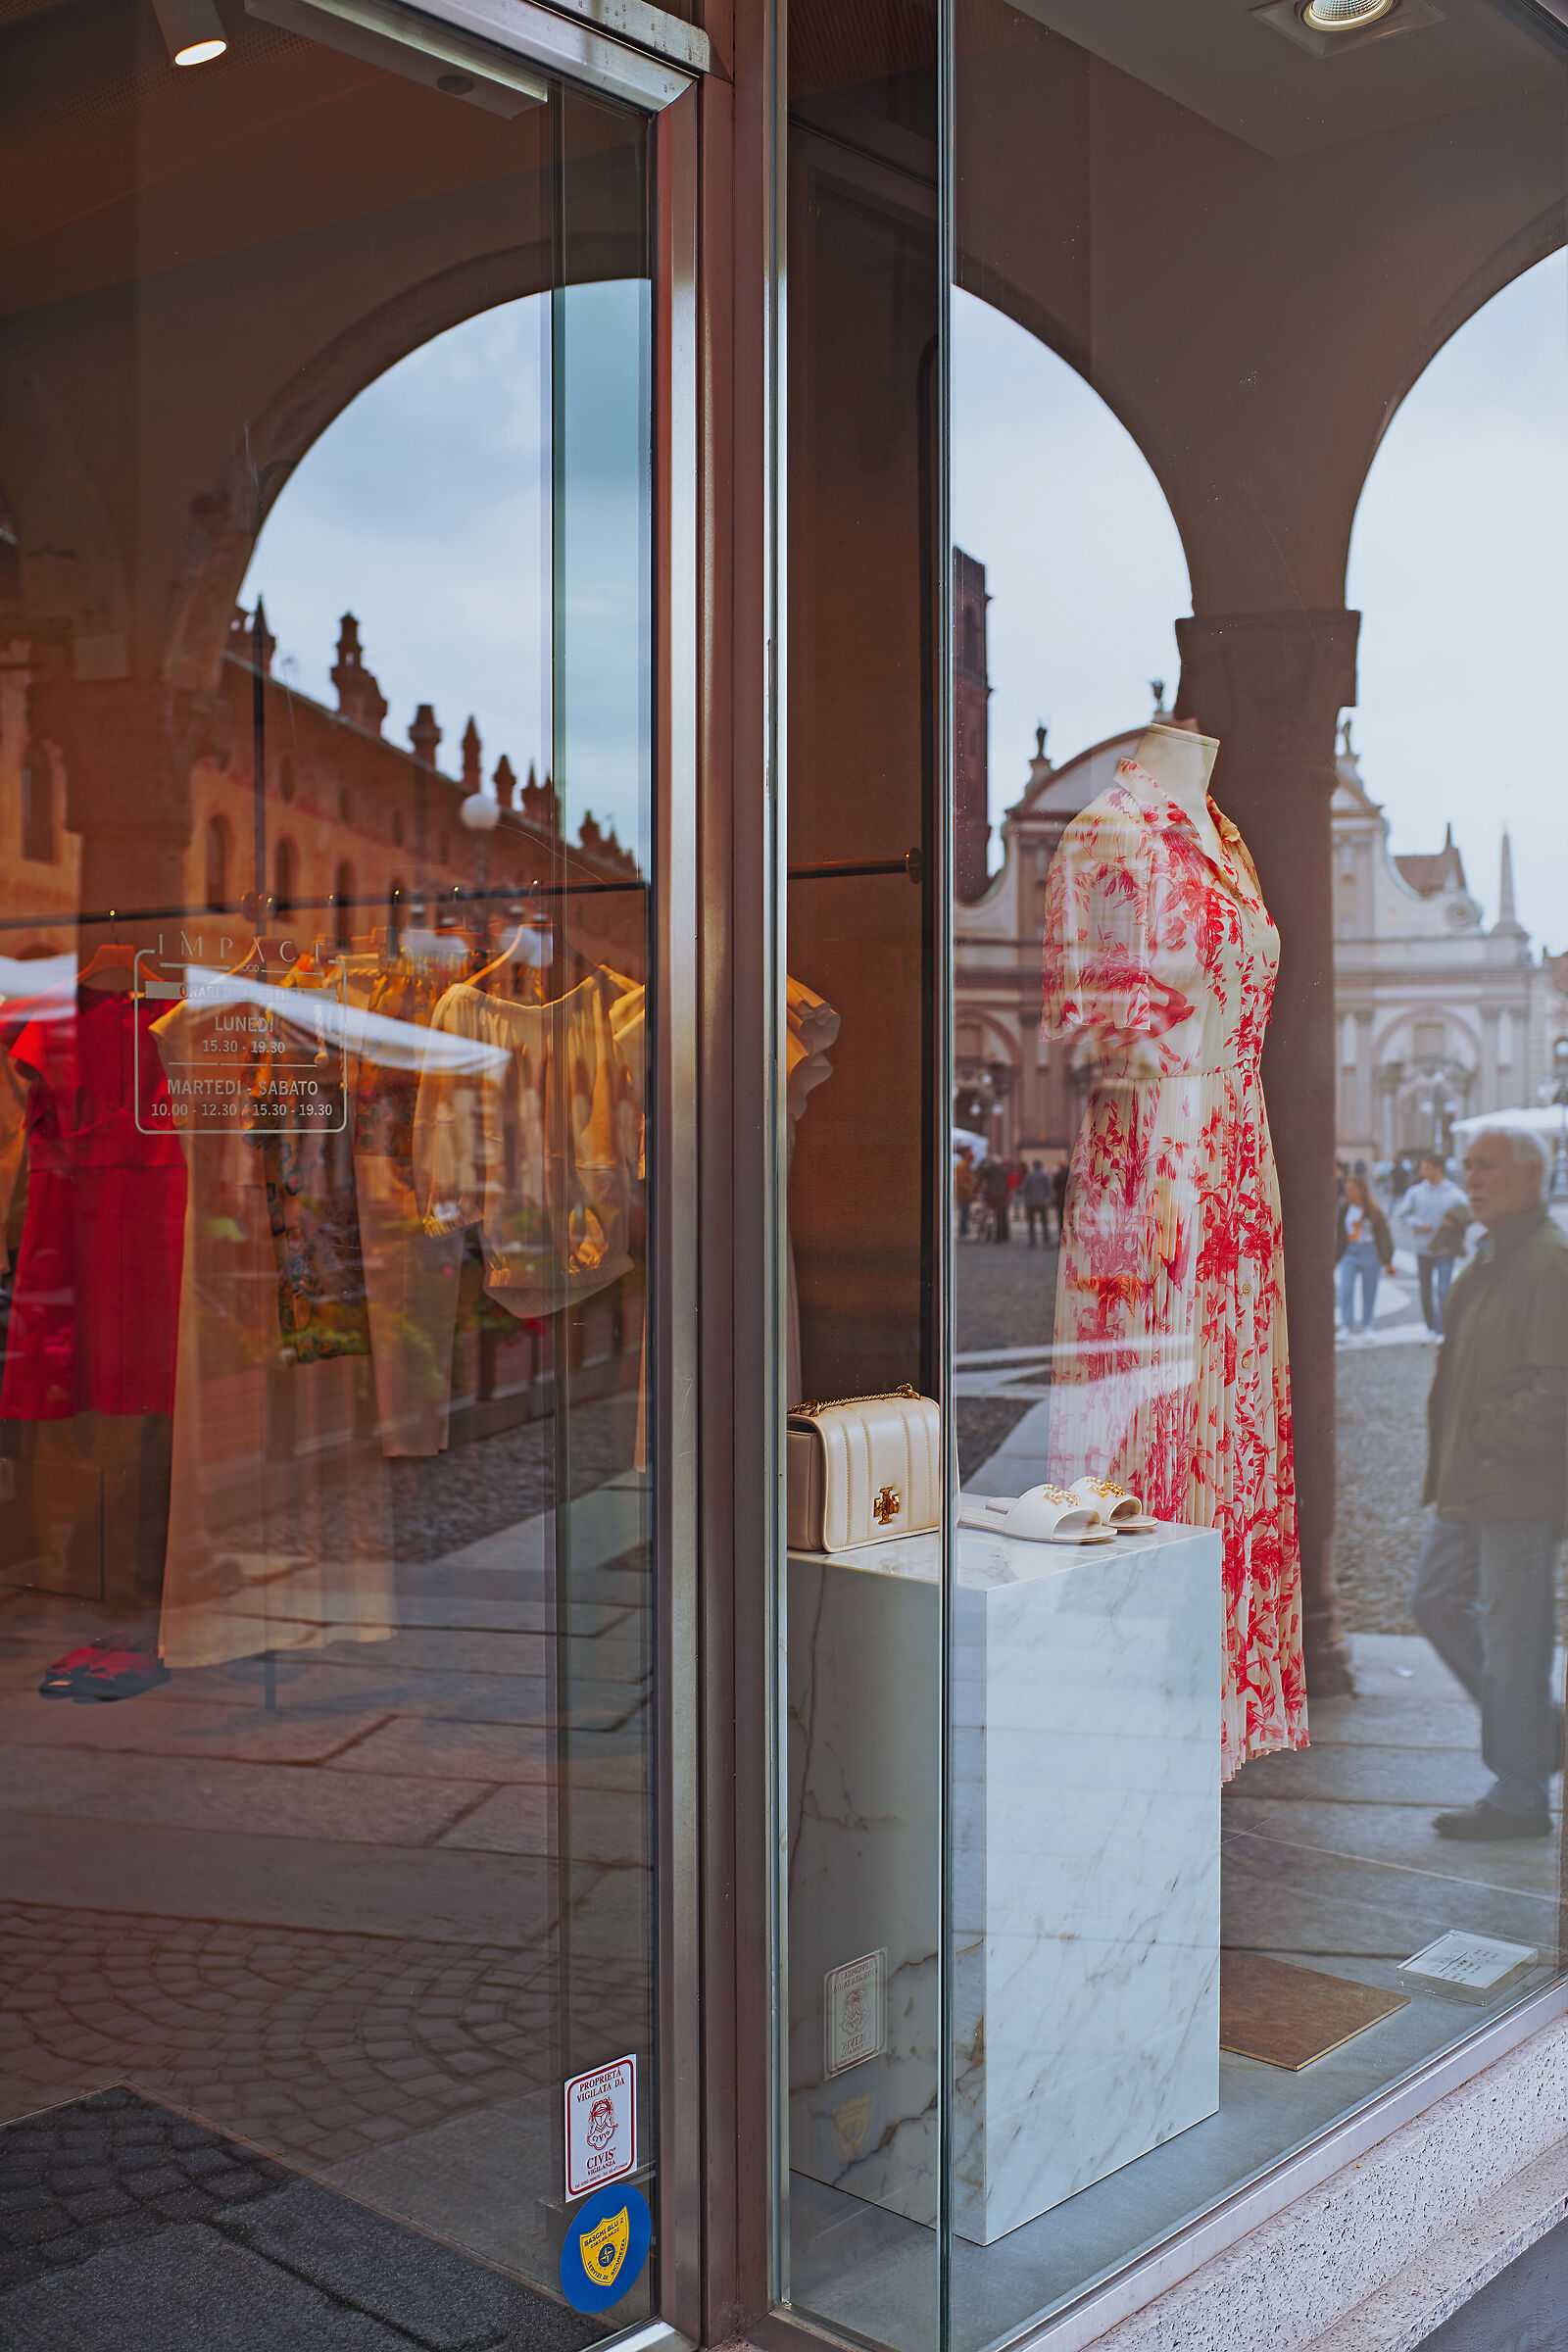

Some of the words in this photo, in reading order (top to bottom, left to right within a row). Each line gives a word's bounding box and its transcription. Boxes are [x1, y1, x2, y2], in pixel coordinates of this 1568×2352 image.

[159, 931, 325, 963] IMPACT
[203, 1040, 238, 1053] 15.30
[251, 1041, 286, 1054] 19.30
[167, 1079, 241, 1096] MARTEDI
[259, 1080, 318, 1097] SABATO
[151, 1103, 188, 1116] 10.00
[202, 1103, 237, 1116] 12.30
[253, 1103, 287, 1116] 15.30
[298, 1103, 333, 1116] 19.30
[579, 2066, 622, 2092] PROPRIETÀ
[576, 2083, 612, 2103] VIGILATA
[614, 2077, 625, 2088] DA
[587, 2159, 616, 2176] VIGILANZA
[584, 2229, 607, 2246] BASCHI
[607, 2221, 619, 2232] BLU
